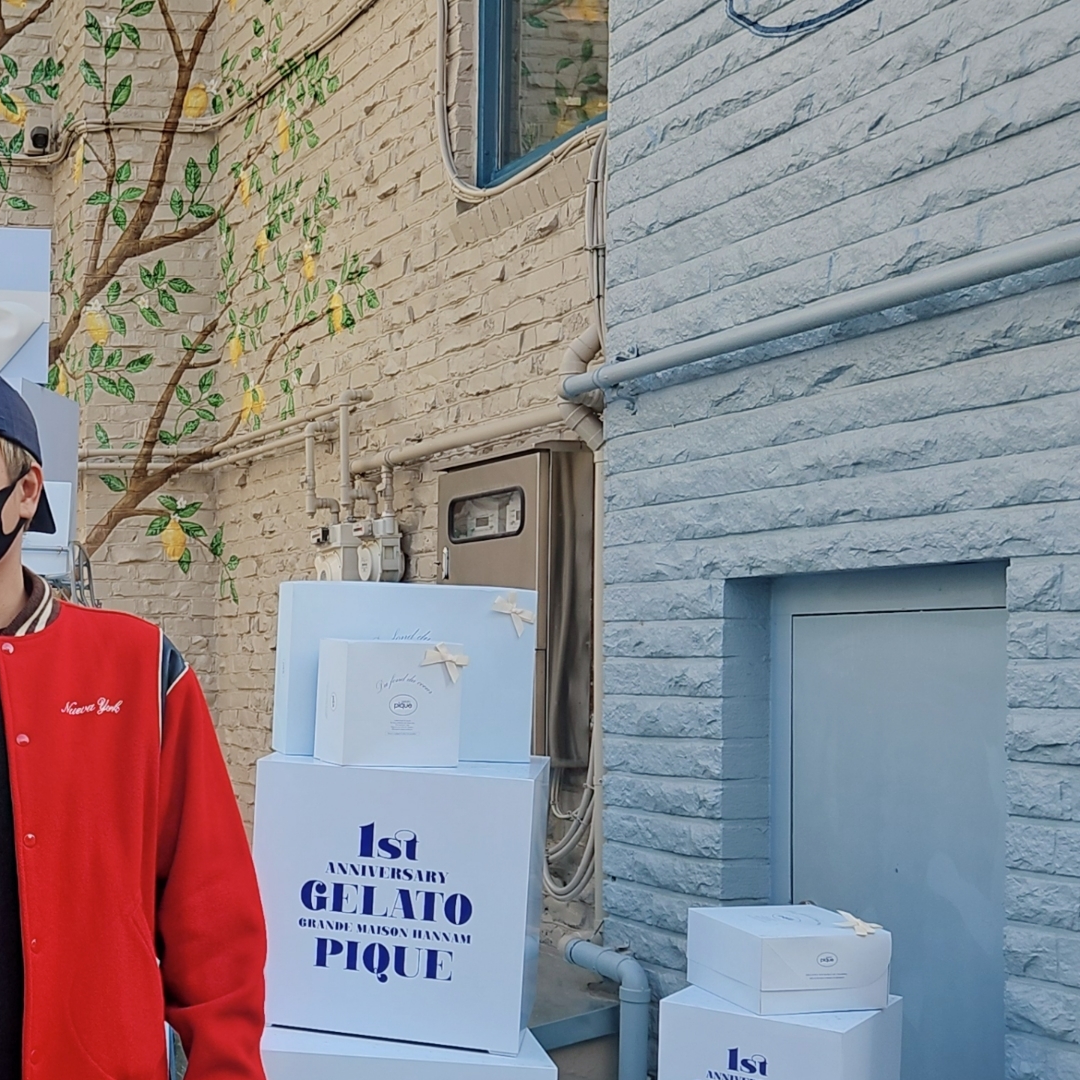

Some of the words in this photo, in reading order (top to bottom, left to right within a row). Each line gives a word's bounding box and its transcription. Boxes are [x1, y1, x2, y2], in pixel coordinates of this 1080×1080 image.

[61, 701, 96, 715] Nueva
[97, 697, 123, 715] York
[357, 821, 420, 861] 1st
[325, 862, 450, 884] ANNIVERSARY
[300, 879, 473, 926] GELATO
[298, 917, 353, 932] GRANDE
[357, 923, 409, 938] MAISON
[412, 929, 471, 944] HANNAM
[313, 937, 454, 983] PIQUE
[727, 1047, 768, 1077] 1st
